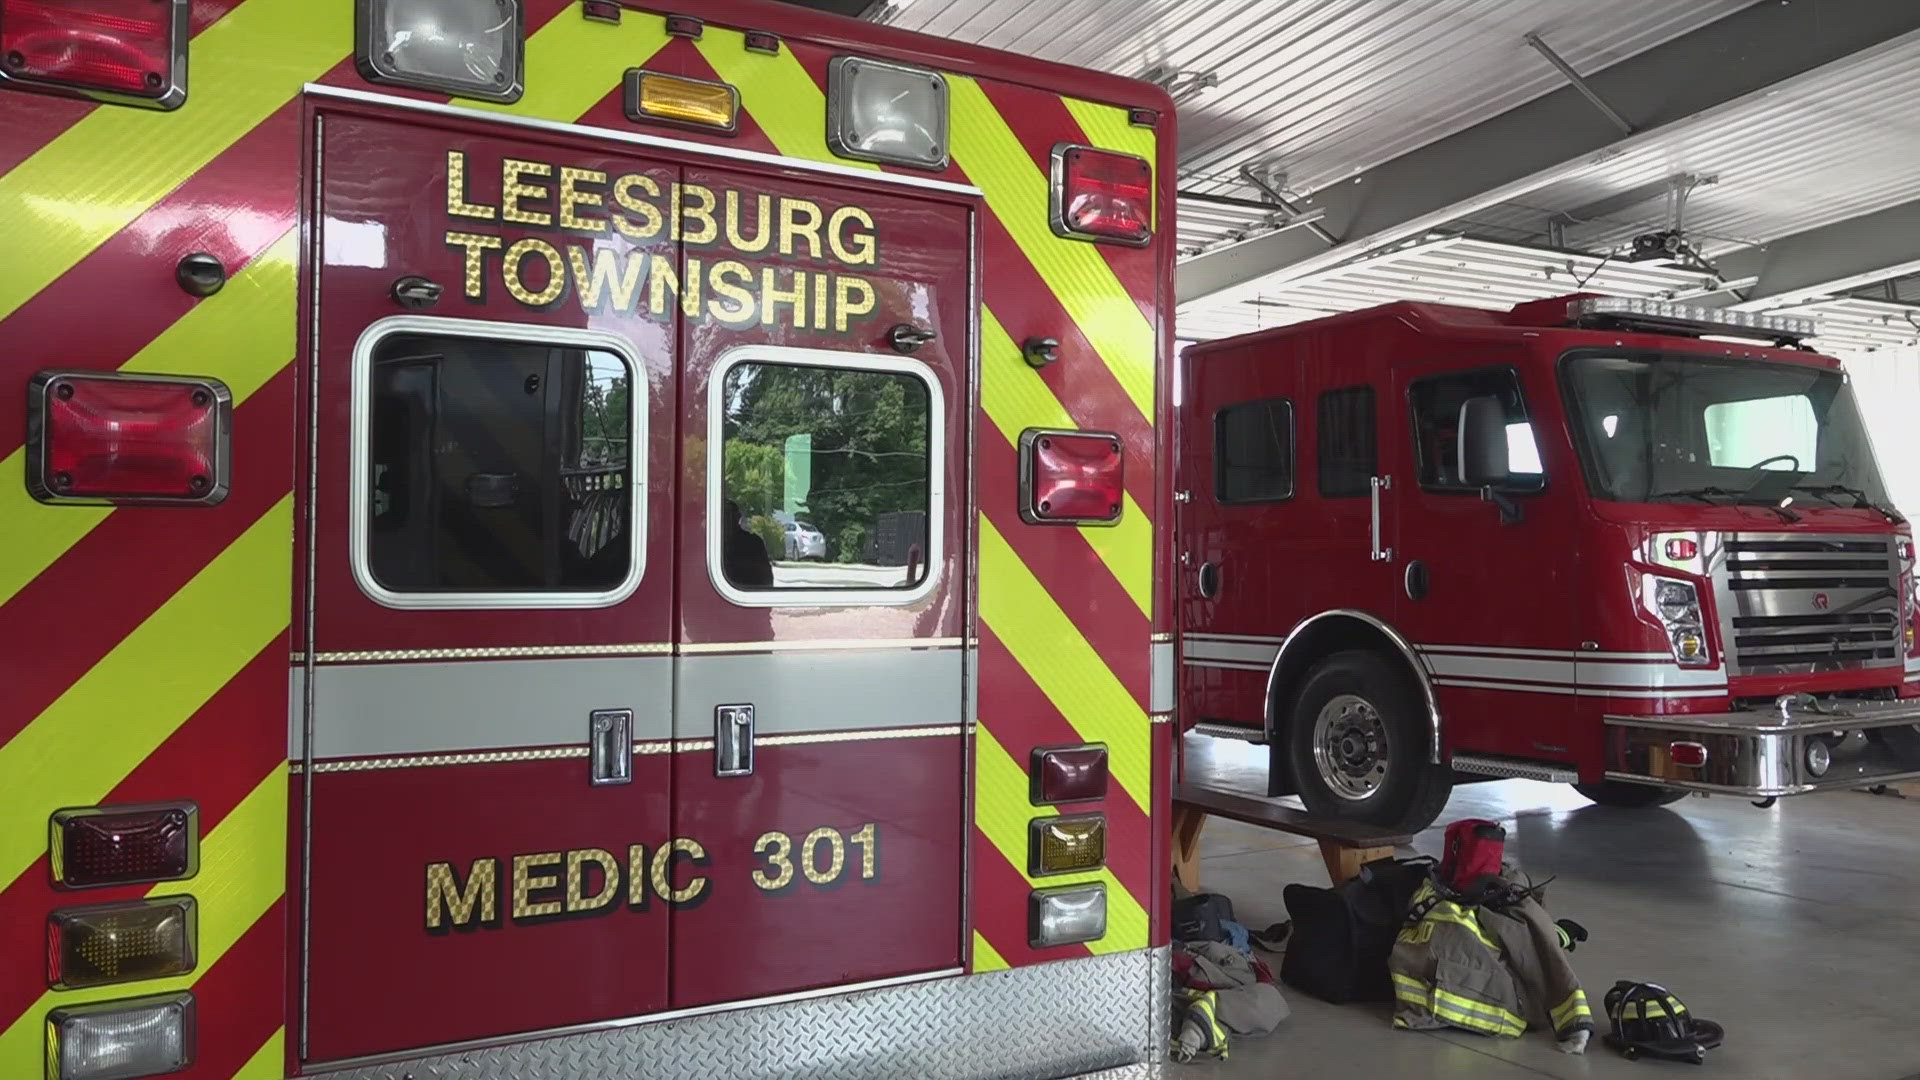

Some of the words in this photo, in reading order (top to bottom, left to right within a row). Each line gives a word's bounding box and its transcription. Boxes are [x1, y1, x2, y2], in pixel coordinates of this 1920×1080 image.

[447, 150, 876, 266] LEESBURG
[445, 231, 878, 333] TOWNSHIP
[426, 838, 706, 928] MEDIC
[752, 824, 875, 889] 301
